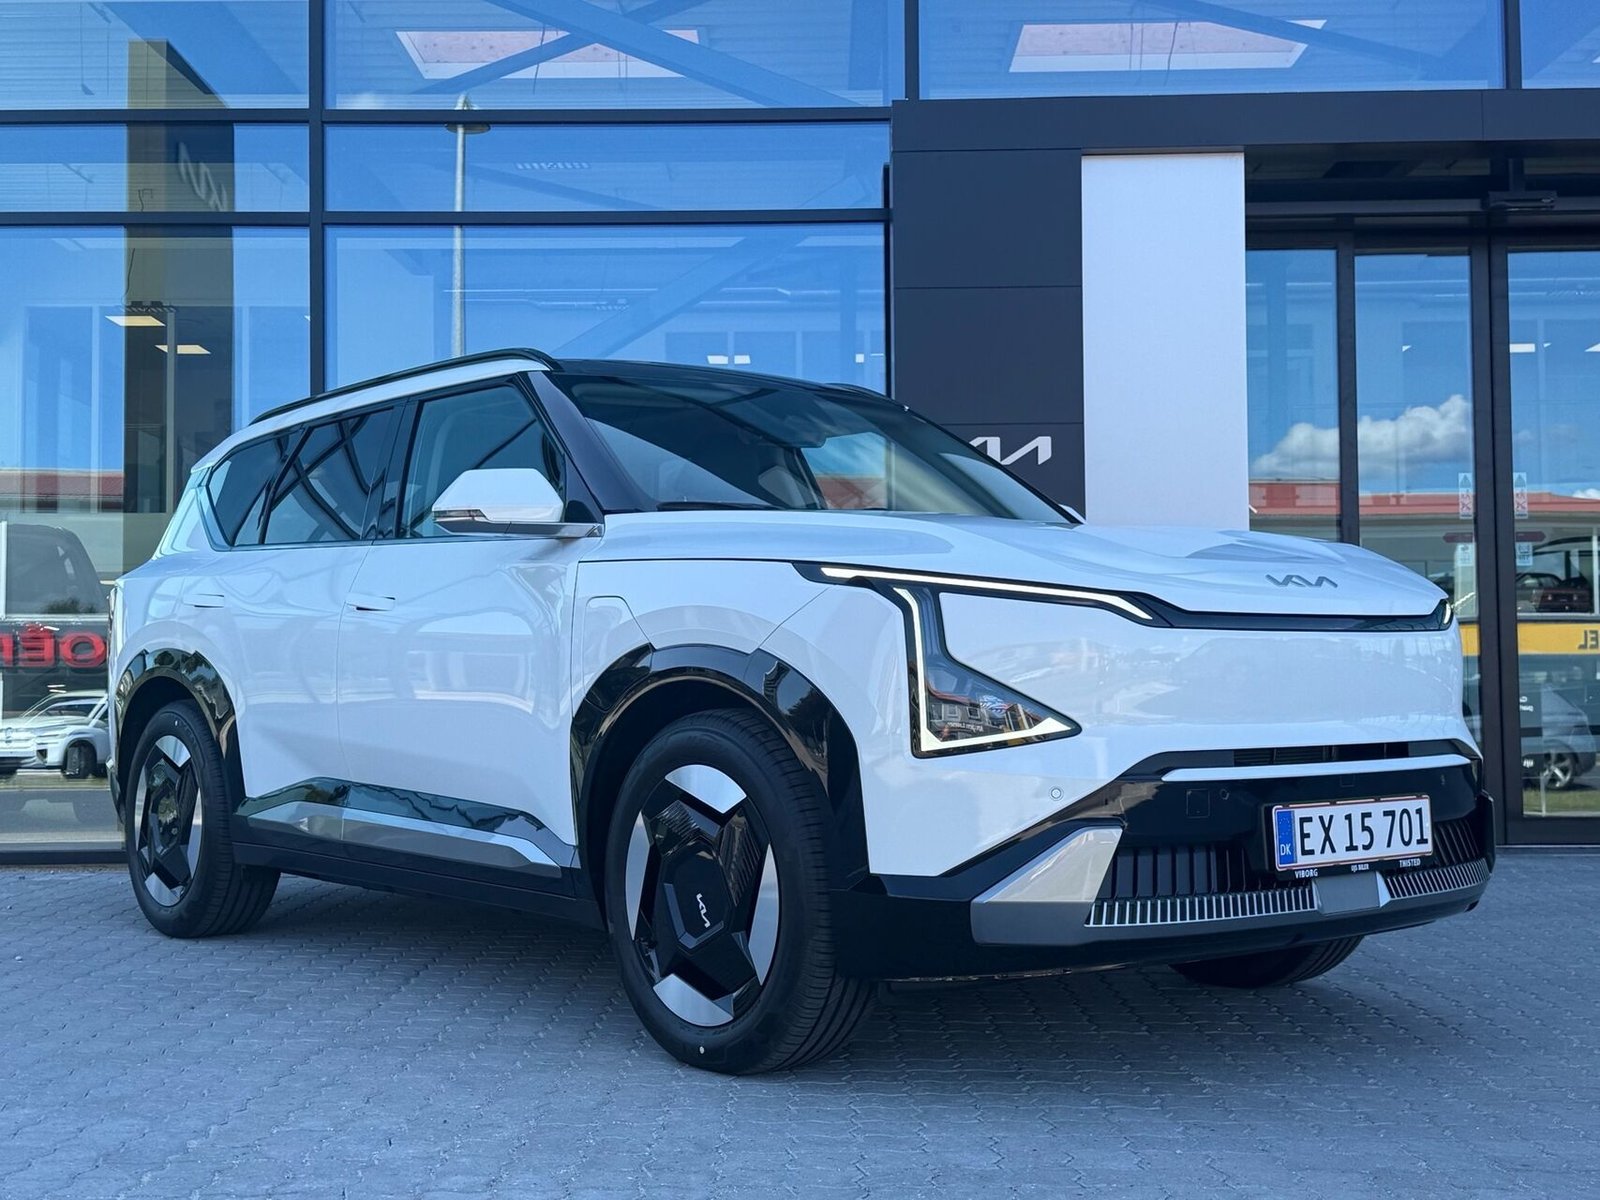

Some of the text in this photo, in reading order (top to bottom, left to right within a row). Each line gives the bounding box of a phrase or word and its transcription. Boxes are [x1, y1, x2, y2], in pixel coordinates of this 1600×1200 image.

[968, 436, 1052, 465] IA
[1265, 574, 1338, 588] KIA
[1299, 807, 1429, 857] EX 15 701
[1280, 843, 1292, 856] DK
[1295, 868, 1319, 879] VIBORG
